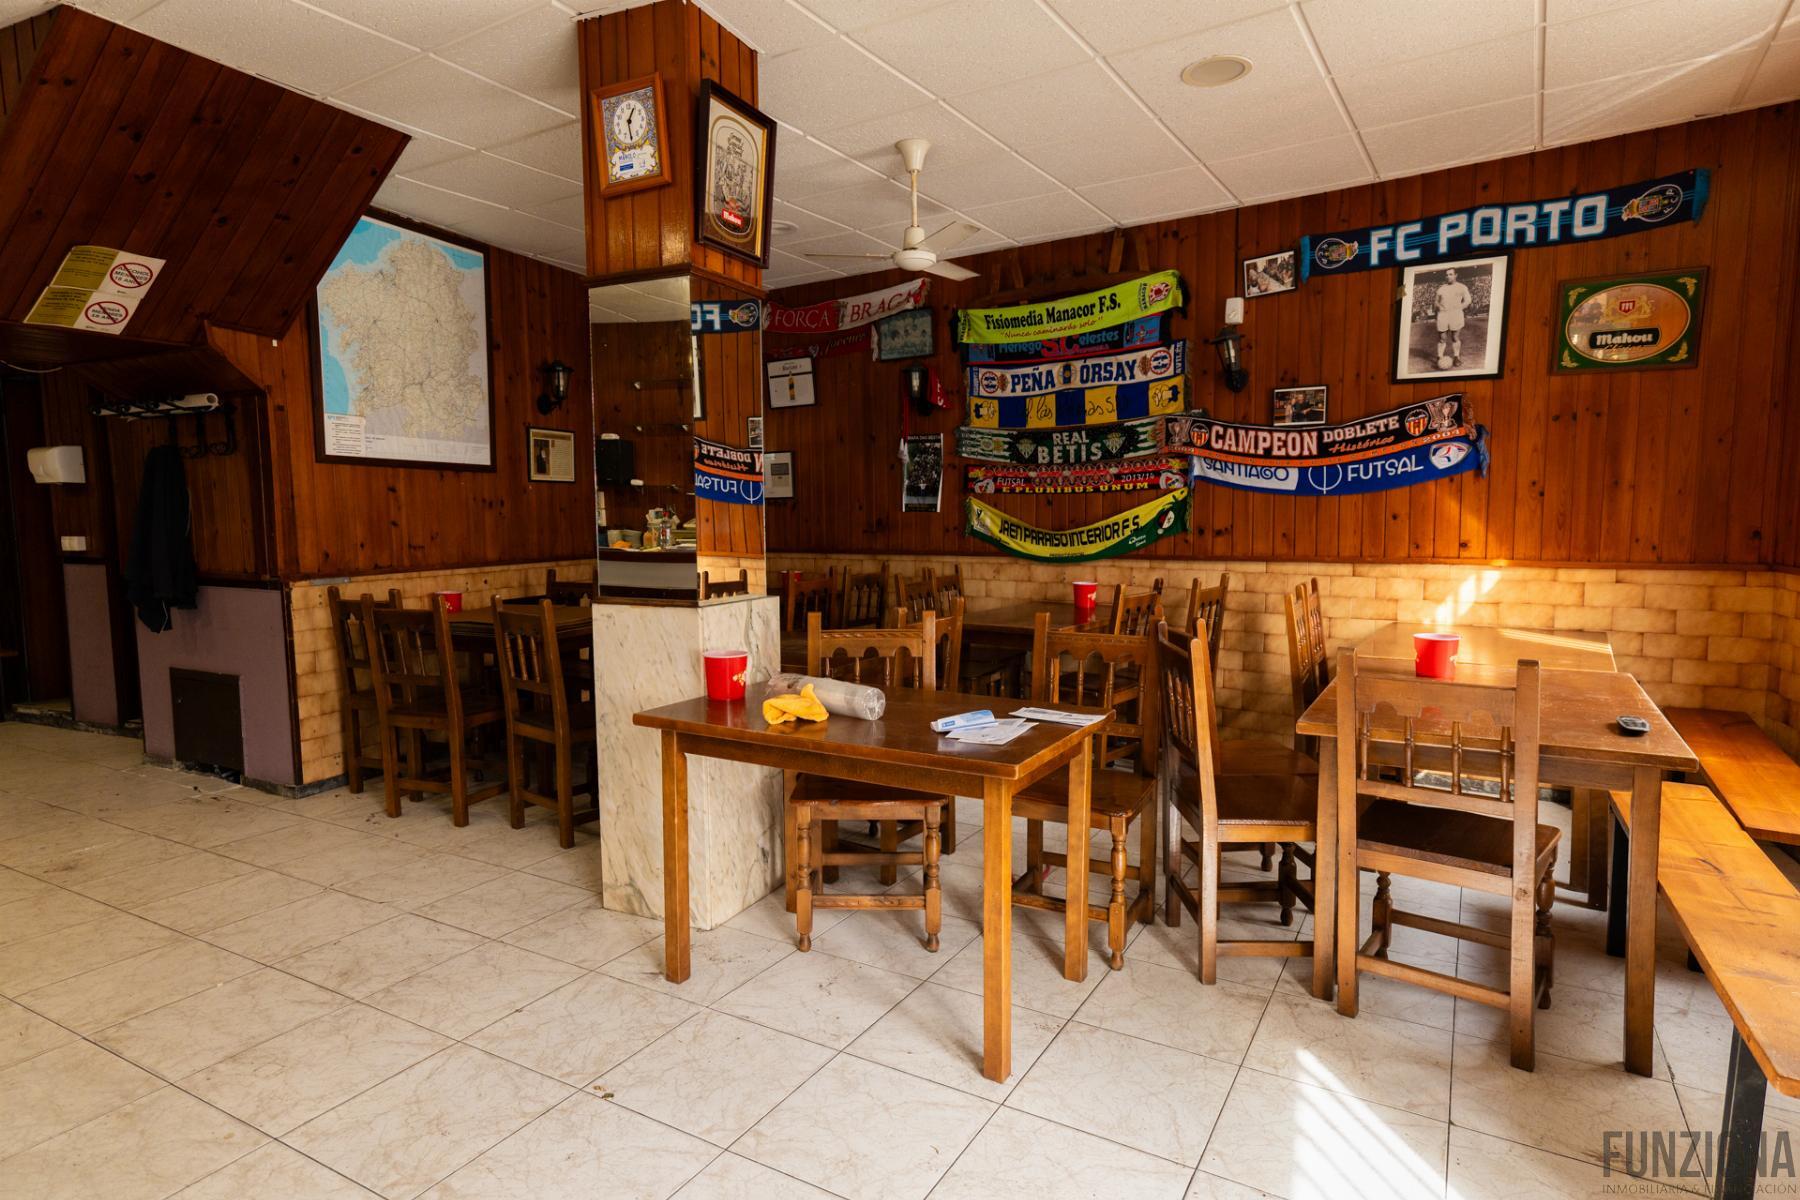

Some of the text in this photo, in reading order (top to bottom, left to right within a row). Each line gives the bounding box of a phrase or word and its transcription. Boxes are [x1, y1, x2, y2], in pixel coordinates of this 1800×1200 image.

[1369, 194, 1609, 266] FC PORTO
[984, 309, 1045, 331] Fisiomedia
[1046, 303, 1097, 324] Manacor
[1098, 293, 1121, 315] F.S.
[1595, 332, 1654, 347] Mahou
[1010, 367, 1056, 393] PEÑA
[1079, 357, 1138, 384] ÓRSAY
[1052, 430, 1090, 447] REAL
[1210, 424, 1318, 457] CAMPEON
[1321, 415, 1400, 444] DOBLETE
[1037, 441, 1103, 464] BETIS
[1203, 454, 1424, 482] SANTIAGO FUTSAL
[1013, 485, 1094, 495] PLURIBUS
[1099, 481, 1149, 493] UNUM
[1069, 522, 1121, 548] INTERIOR
